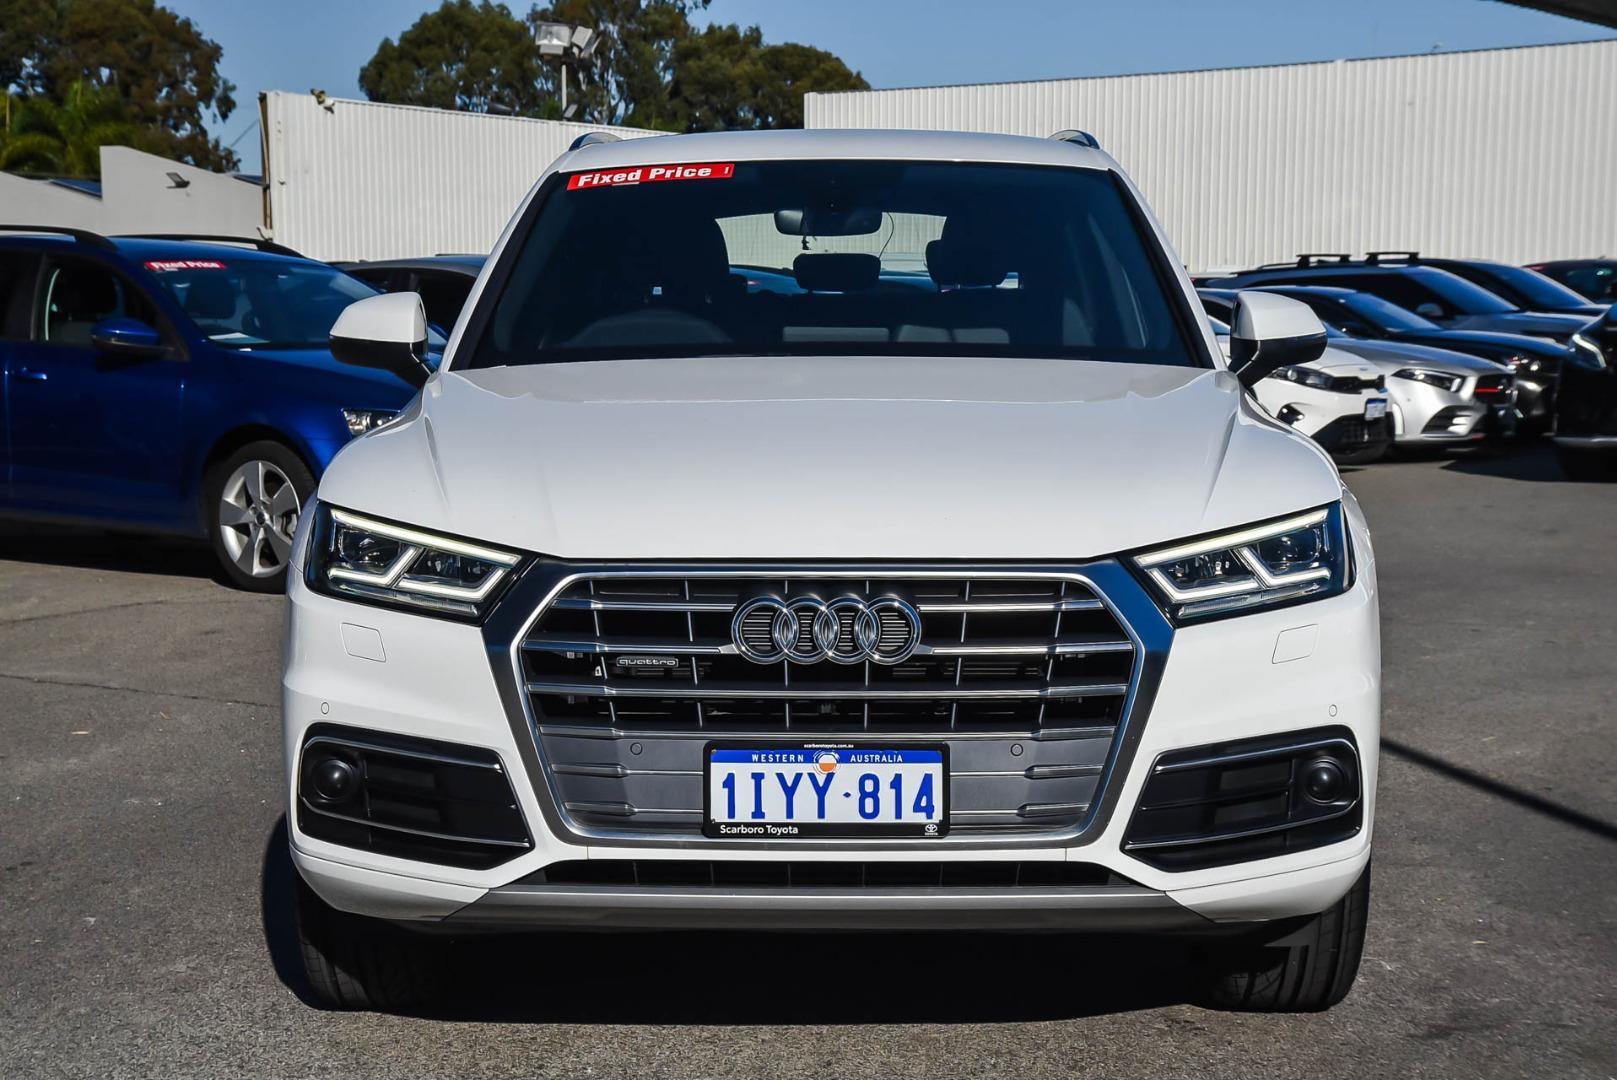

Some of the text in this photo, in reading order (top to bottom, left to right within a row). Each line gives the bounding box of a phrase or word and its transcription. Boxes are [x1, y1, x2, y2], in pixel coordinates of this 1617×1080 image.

[577, 166, 712, 187] Fixed Price
[150, 261, 220, 269] Fixed Price
[752, 754, 804, 762] WESTERN
[850, 754, 903, 763] AUSTRALIA
[720, 825, 799, 836] Scarboro Toyota
